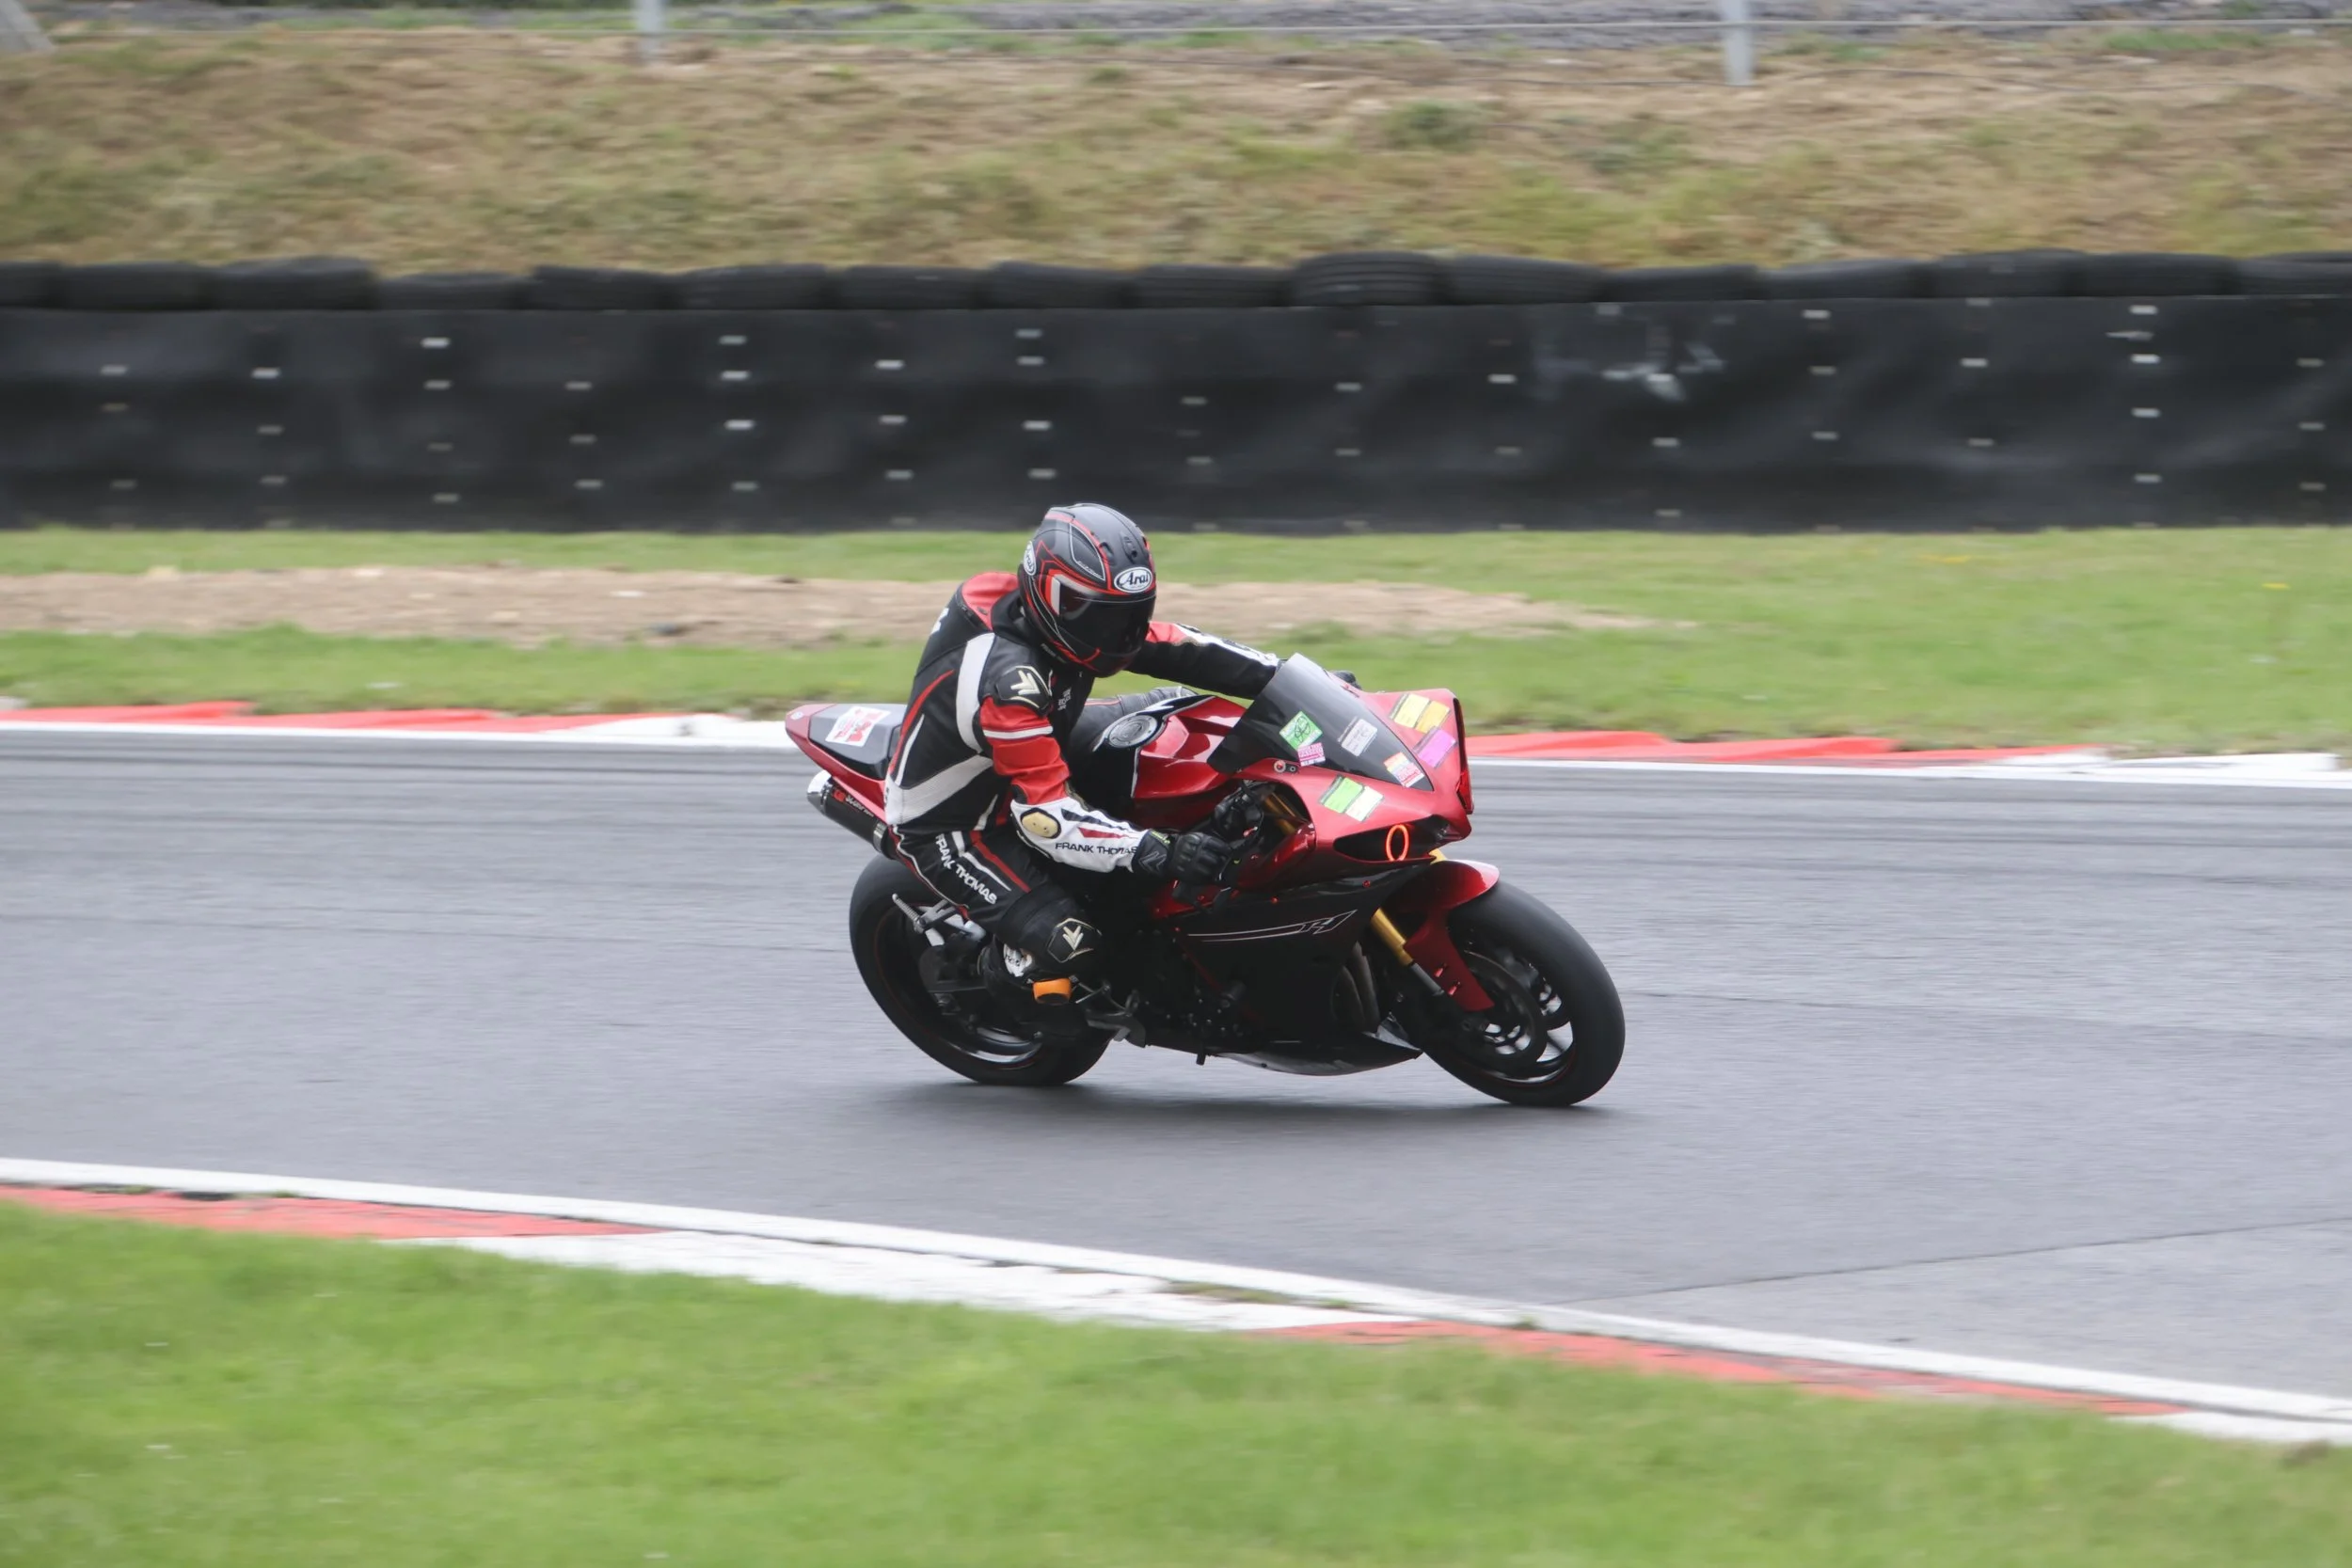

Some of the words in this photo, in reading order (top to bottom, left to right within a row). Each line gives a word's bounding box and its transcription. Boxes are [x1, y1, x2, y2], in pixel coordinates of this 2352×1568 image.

[1117, 571, 1149, 586] Arai
[1055, 842, 1094, 853] FRANK
[935, 832, 956, 870] FRANK
[955, 863, 997, 905] THOMAS
